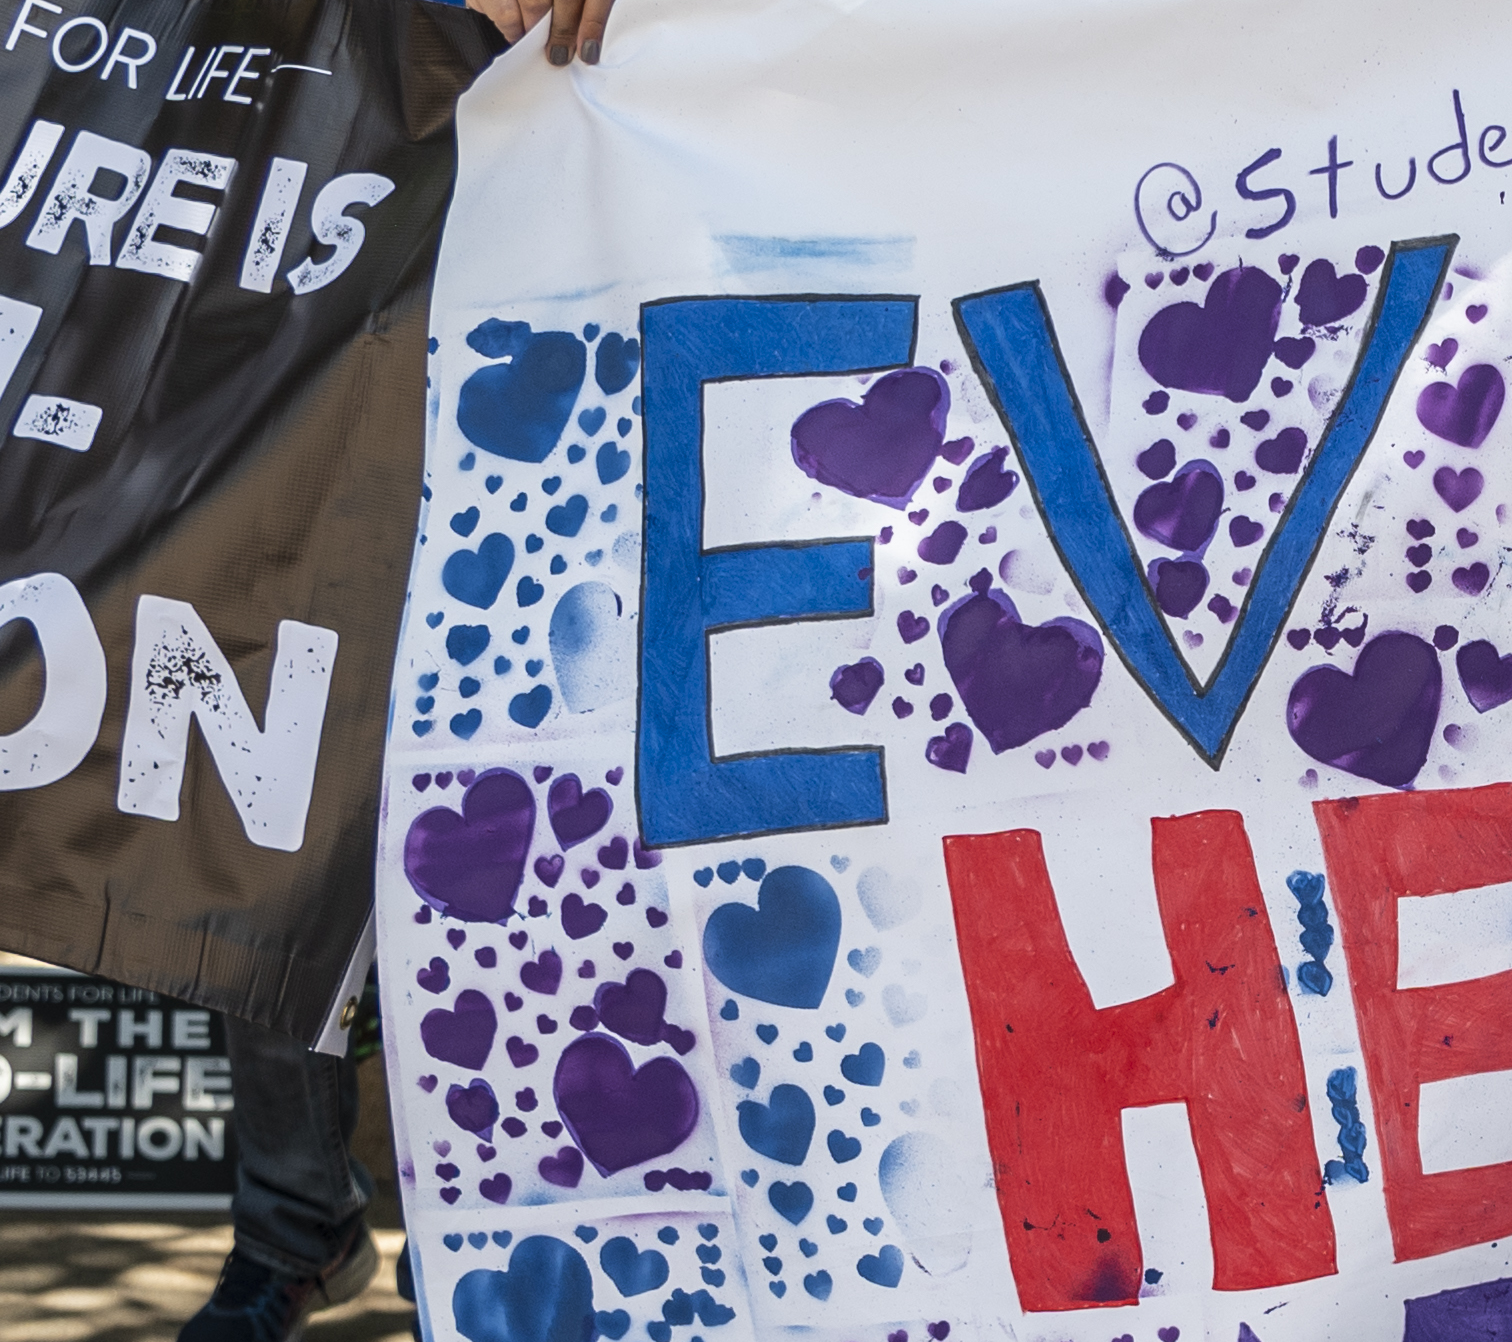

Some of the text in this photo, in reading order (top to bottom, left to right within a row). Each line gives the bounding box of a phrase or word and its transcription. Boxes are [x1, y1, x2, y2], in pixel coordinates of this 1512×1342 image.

[166, 45, 271, 105] LIFE
[238, 157, 395, 297] IS
[67, 985, 114, 1003] FOR
[68, 1008, 211, 1049] THE
